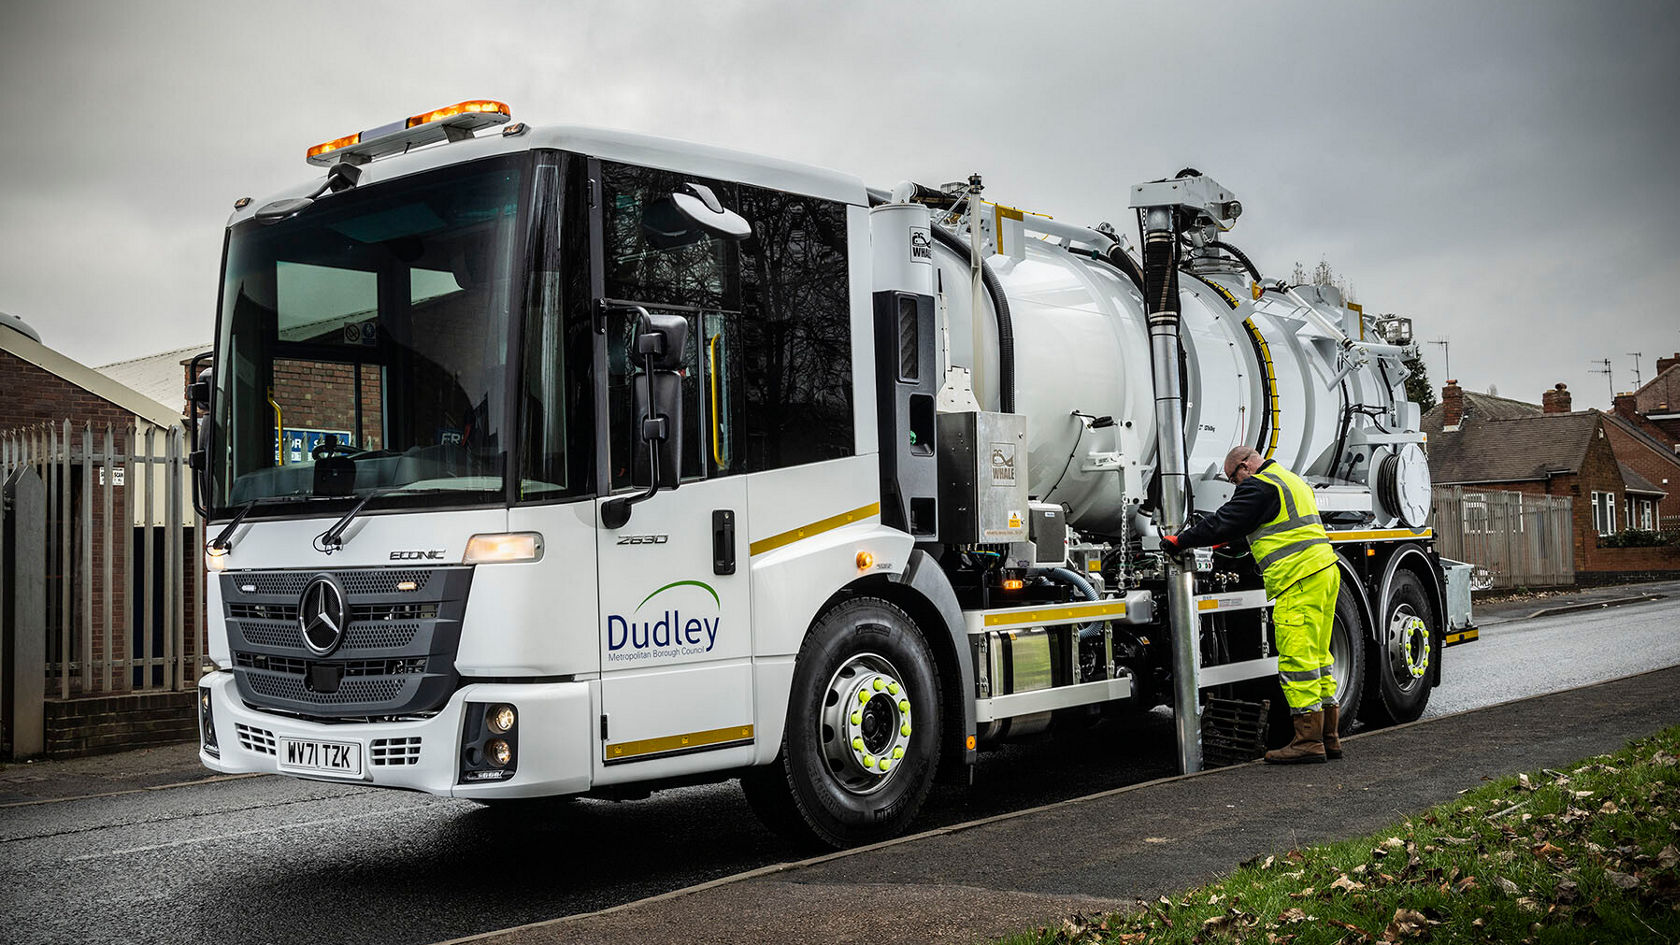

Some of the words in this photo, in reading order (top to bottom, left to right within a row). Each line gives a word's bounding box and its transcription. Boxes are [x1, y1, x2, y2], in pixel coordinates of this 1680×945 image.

[992, 467, 1015, 480] WHALE
[616, 535, 669, 545] 2630
[389, 549, 447, 560] ECONIC
[607, 609, 720, 652] Dudley
[608, 650, 652, 662] Metropolitan
[653, 647, 681, 659] Borough
[681, 645, 705, 656] Council
[288, 741, 319, 766] WV71
[322, 744, 351, 769] TZK
